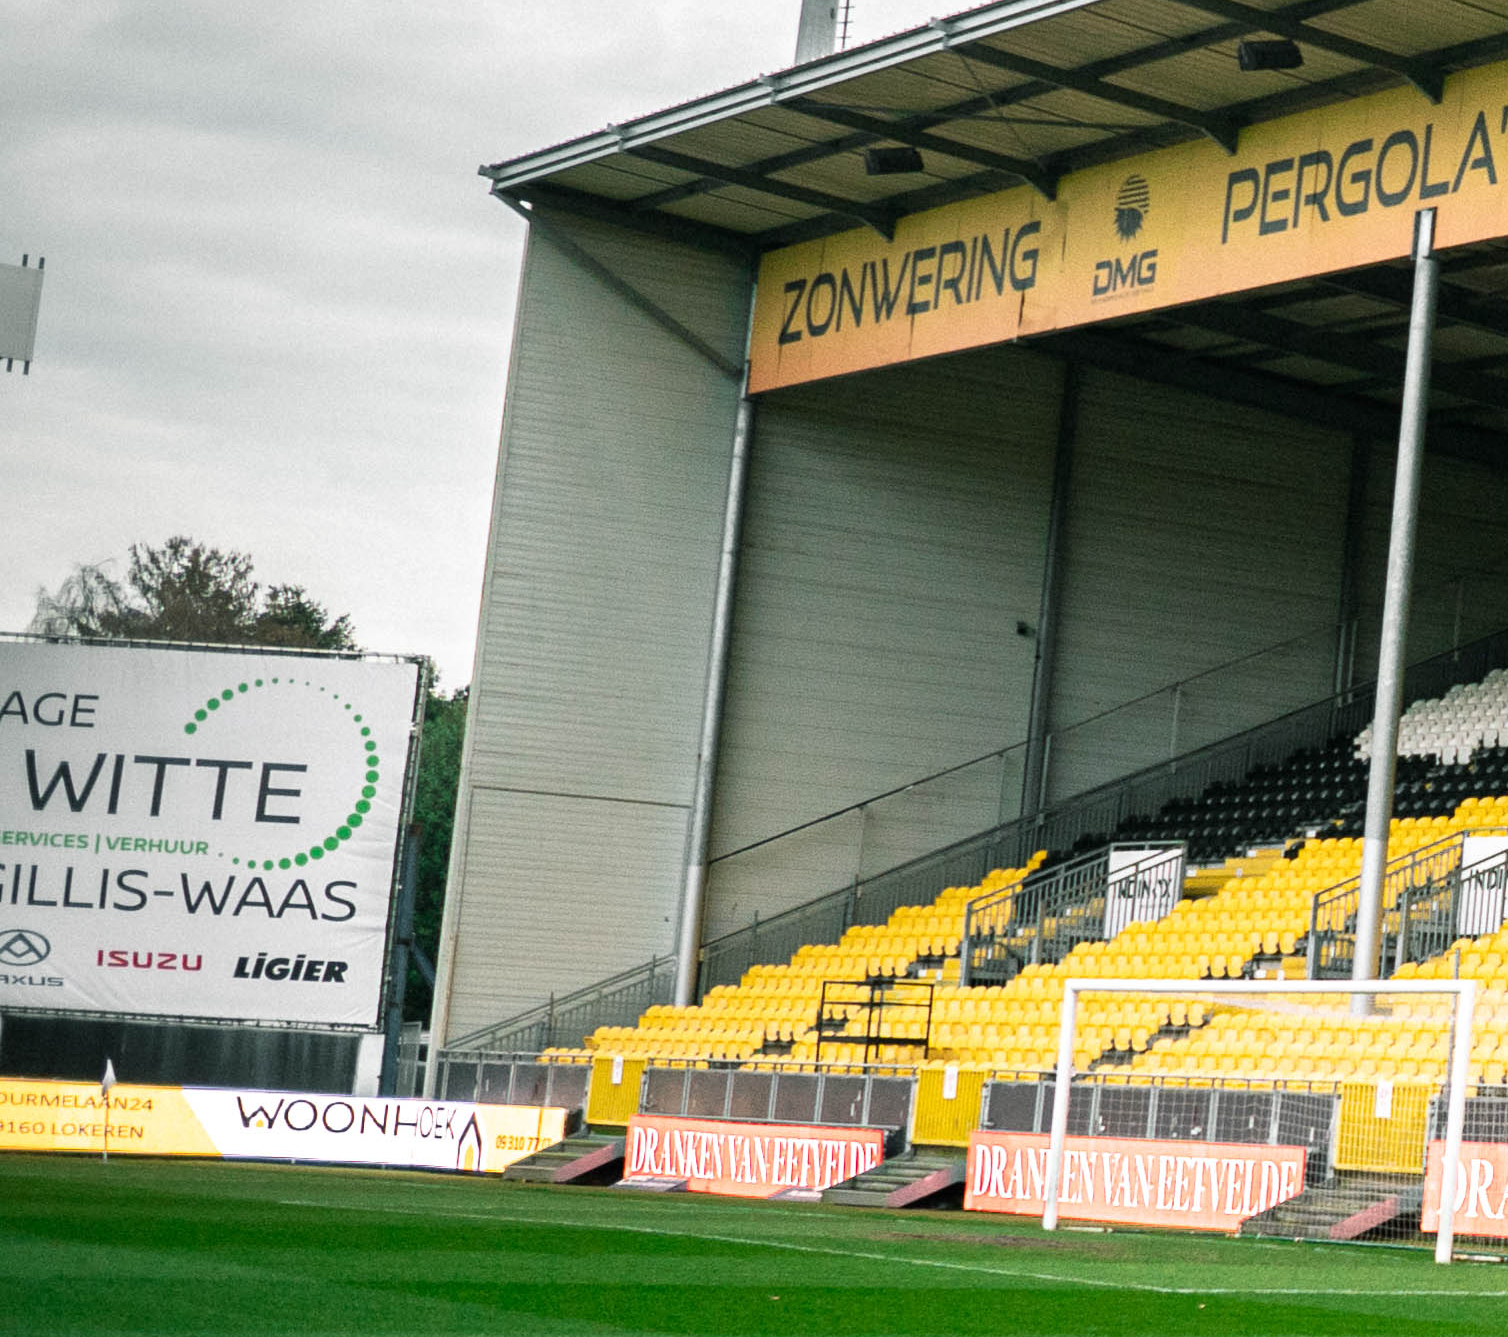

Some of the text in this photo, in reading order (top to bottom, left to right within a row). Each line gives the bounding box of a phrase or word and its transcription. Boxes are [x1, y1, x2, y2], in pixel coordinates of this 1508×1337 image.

[778, 220, 1041, 346] ZONWERING
[1093, 249, 1158, 296] DMG
[25, 749, 307, 824] WITTE
[106, 836, 209, 855] VERHUUR
[97, 950, 203, 972] ISUZU
[52, 1122, 143, 1138] LOKEREN
[236, 1096, 457, 1139] WOONHOEK
[631, 1126, 725, 1181] DRANKEN
[727, 1134, 767, 1184] VAN
[973, 1143, 1298, 1218] DRANEN VAN EETVELDE
